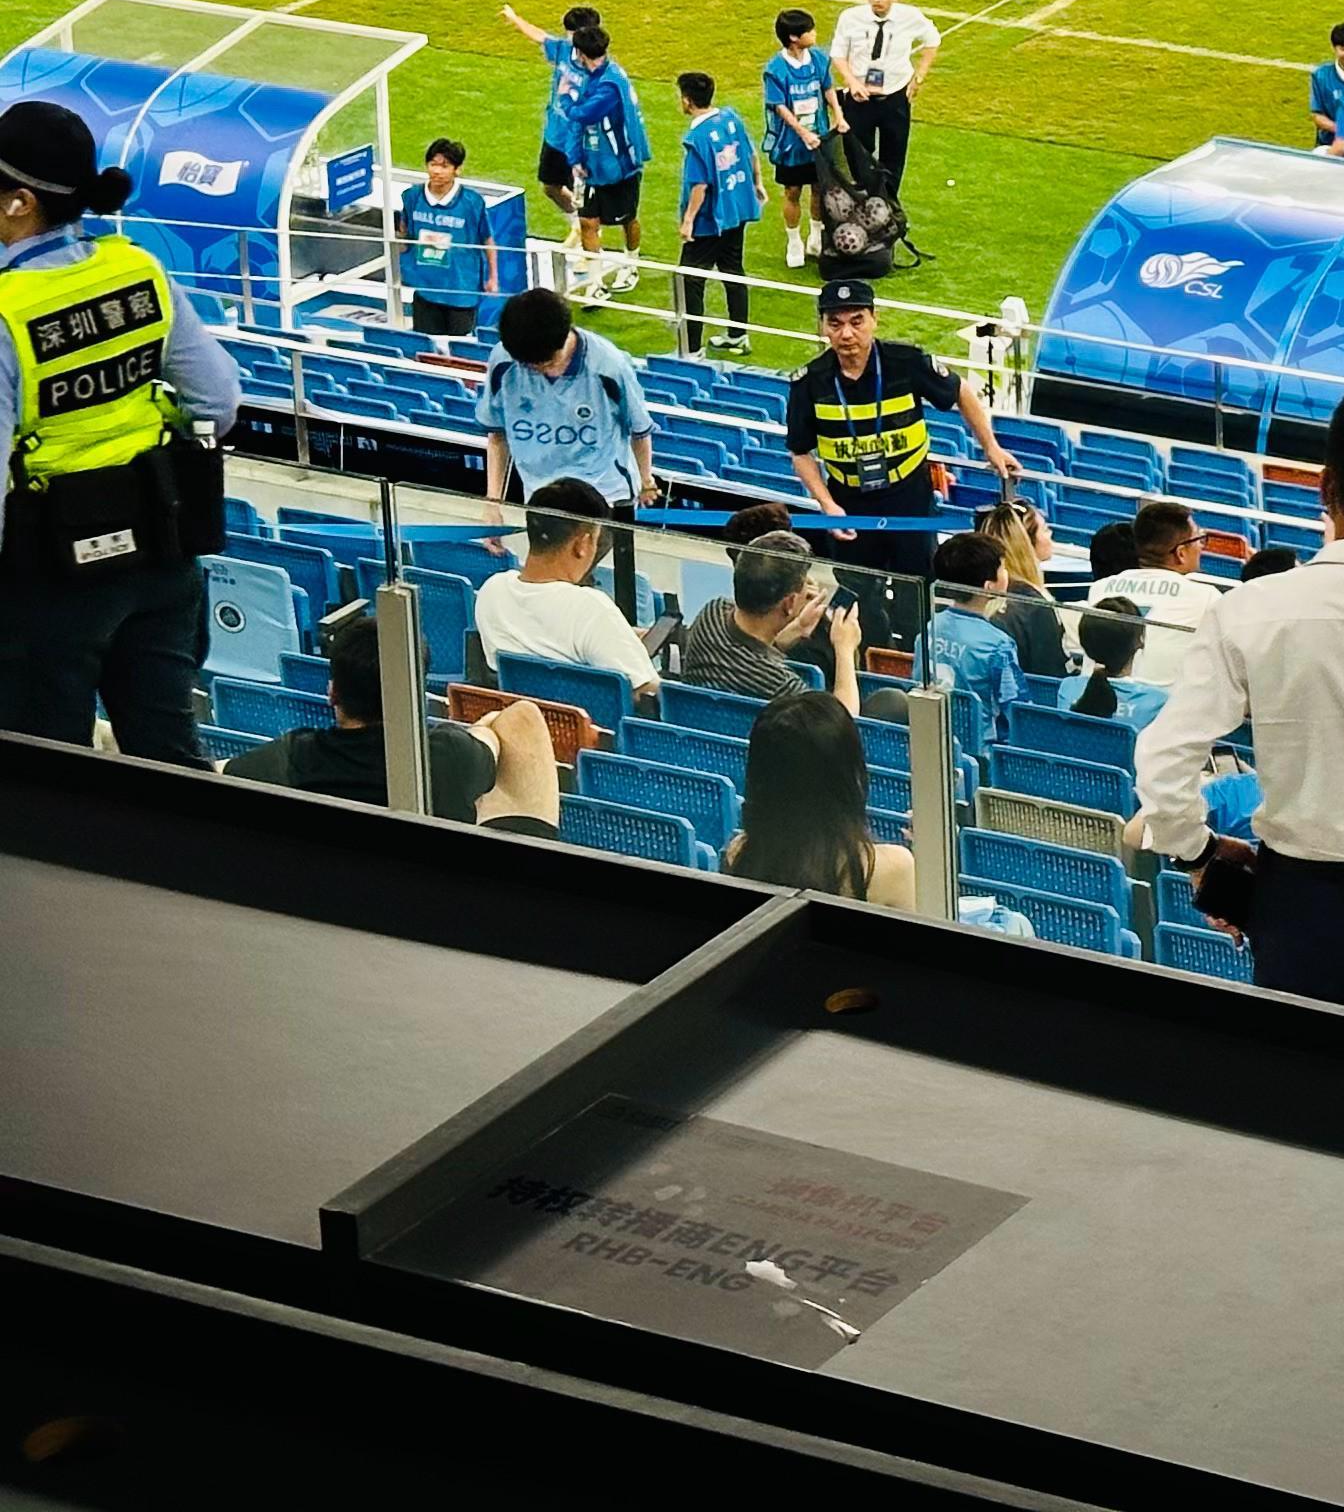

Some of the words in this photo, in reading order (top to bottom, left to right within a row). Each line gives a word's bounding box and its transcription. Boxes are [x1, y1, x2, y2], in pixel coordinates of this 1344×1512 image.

[177, 161, 225, 188] 怡寶
[1184, 279, 1225, 300] CSL
[37, 294, 158, 352] 深圳警察
[51, 348, 156, 408] POLICE
[1104, 578, 1181, 597] RONALDO
[561, 1231, 757, 1294] RHB-ENG
